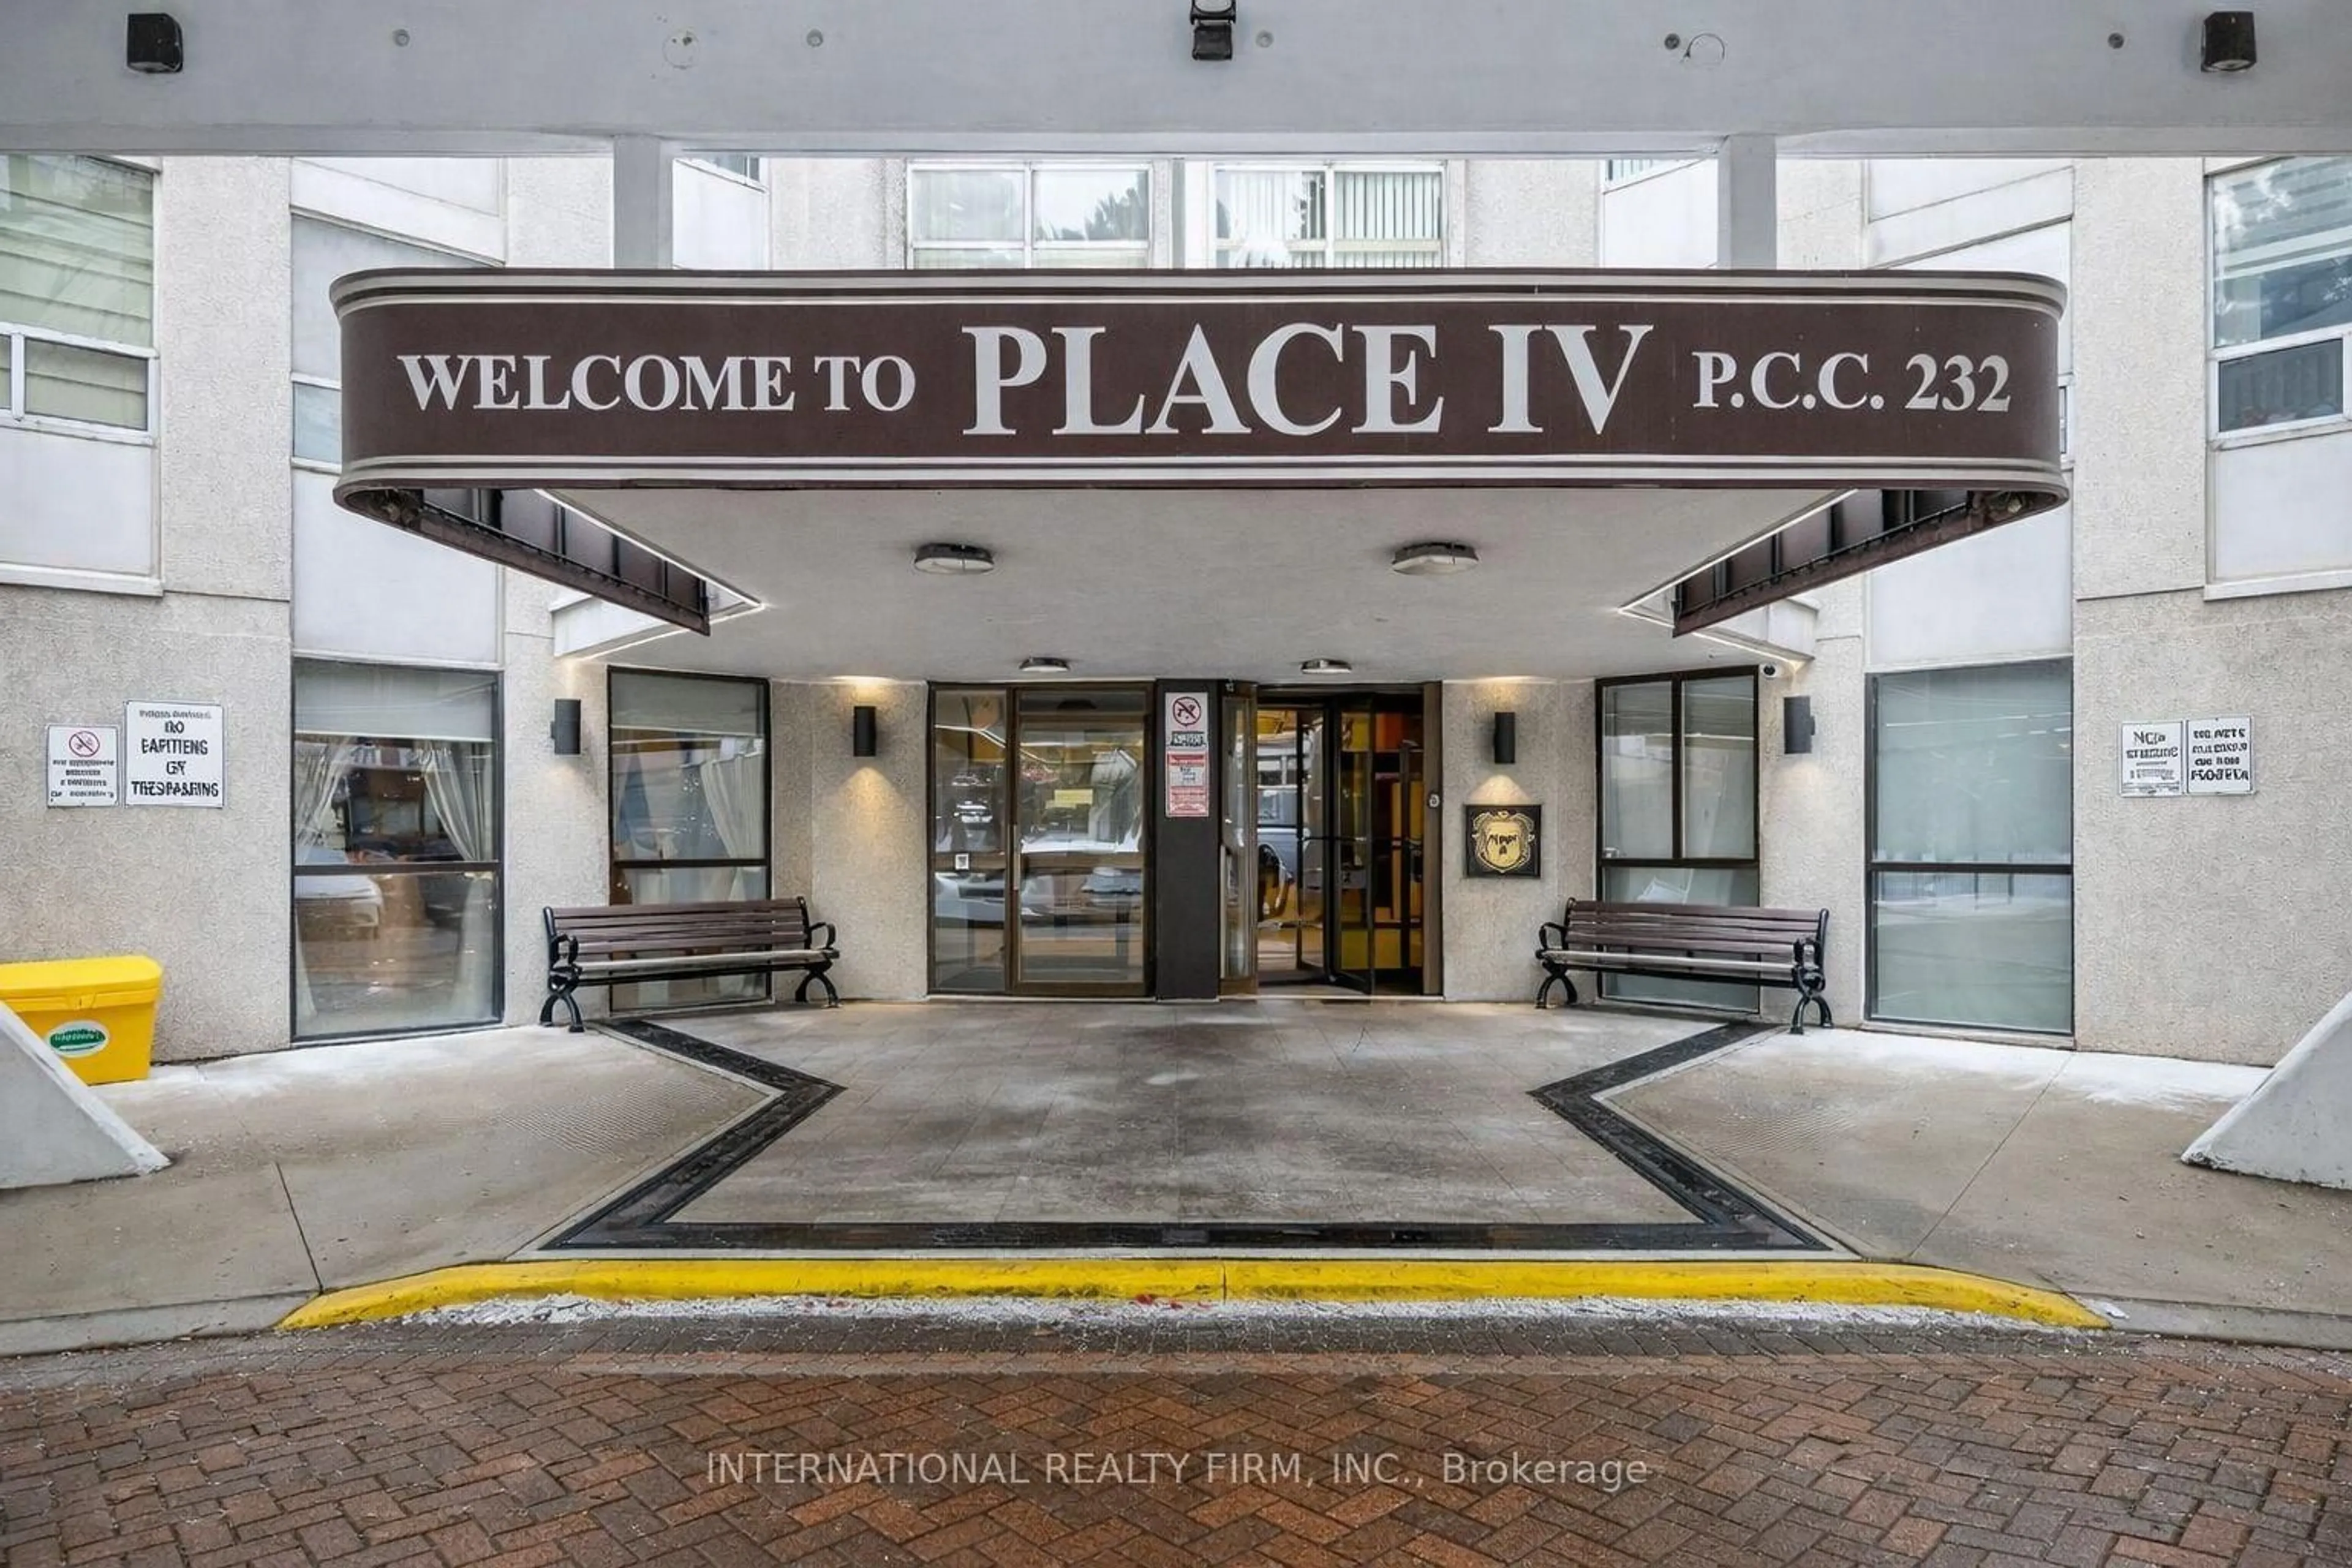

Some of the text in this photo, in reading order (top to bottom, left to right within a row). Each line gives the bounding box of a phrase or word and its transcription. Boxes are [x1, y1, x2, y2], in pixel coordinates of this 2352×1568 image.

[398, 323, 2011, 435] WELCOME TO PLACE IV P.C.C. 232
